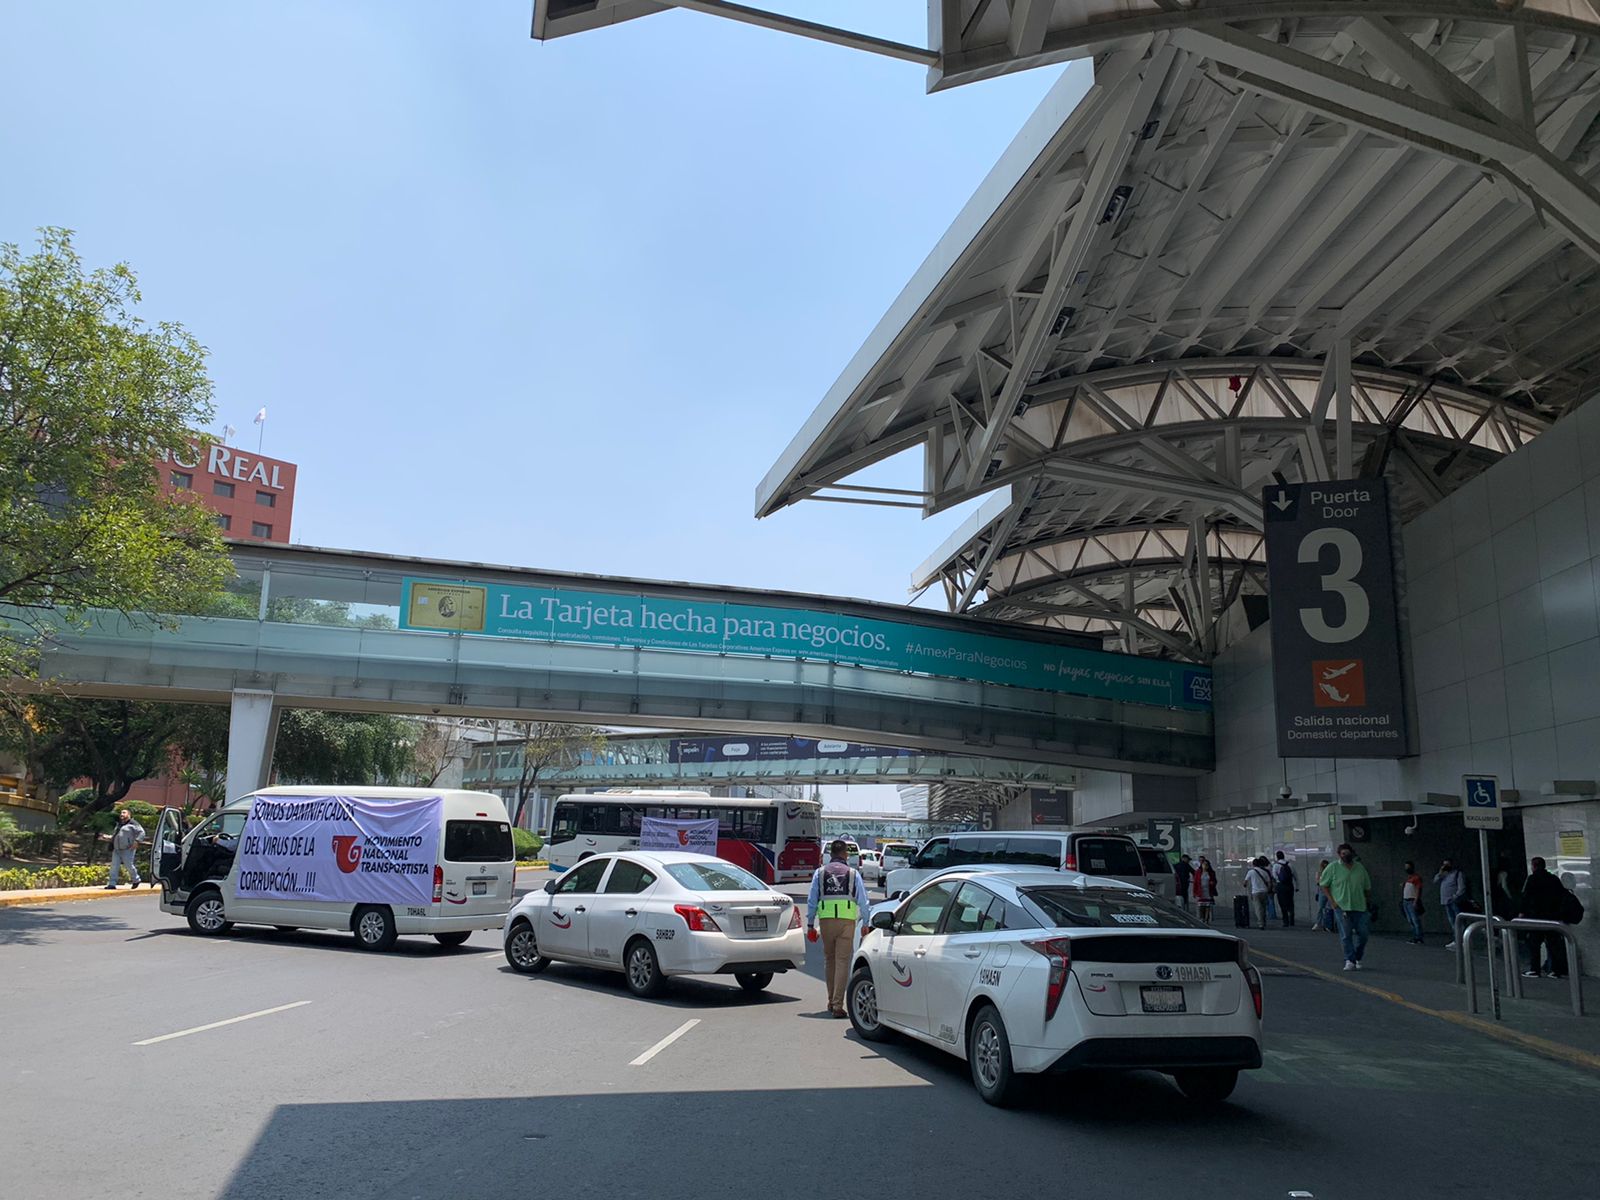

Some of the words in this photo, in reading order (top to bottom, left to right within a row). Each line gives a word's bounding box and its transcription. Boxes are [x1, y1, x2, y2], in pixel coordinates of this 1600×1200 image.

[207, 445, 285, 490] REAL
[1310, 489, 1371, 505] Puerta
[1322, 504, 1359, 519] Door
[1297, 527, 1370, 644] 3
[500, 593, 532, 620] La
[541, 597, 633, 629] Tarjeta
[640, 604, 717, 634] hecha
[723, 617, 776, 641] para
[782, 621, 890, 651] negocios.
[905, 642, 1028, 671] #AmexParaNegocios
[1294, 715, 1333, 727] Salida
[1336, 714, 1390, 726] nacional
[1287, 728, 1337, 739] Domestic
[1340, 728, 1399, 740] departures
[252, 802, 285, 821] SOMOS
[286, 802, 355, 821] DAMNIFICADOS
[982, 812, 993, 830] 5
[364, 836, 423, 848] MOVIMIENTO
[1155, 824, 1175, 851] 3
[244, 836, 264, 855] DEL
[265, 836, 289, 856] VIRUS
[290, 836, 303, 855] DE
[303, 837, 315, 857] LA
[362, 848, 409, 860] NACIONAL
[361, 861, 429, 875] TRANSPORTISTA
[1175, 966, 1212, 981] 19HA5N
